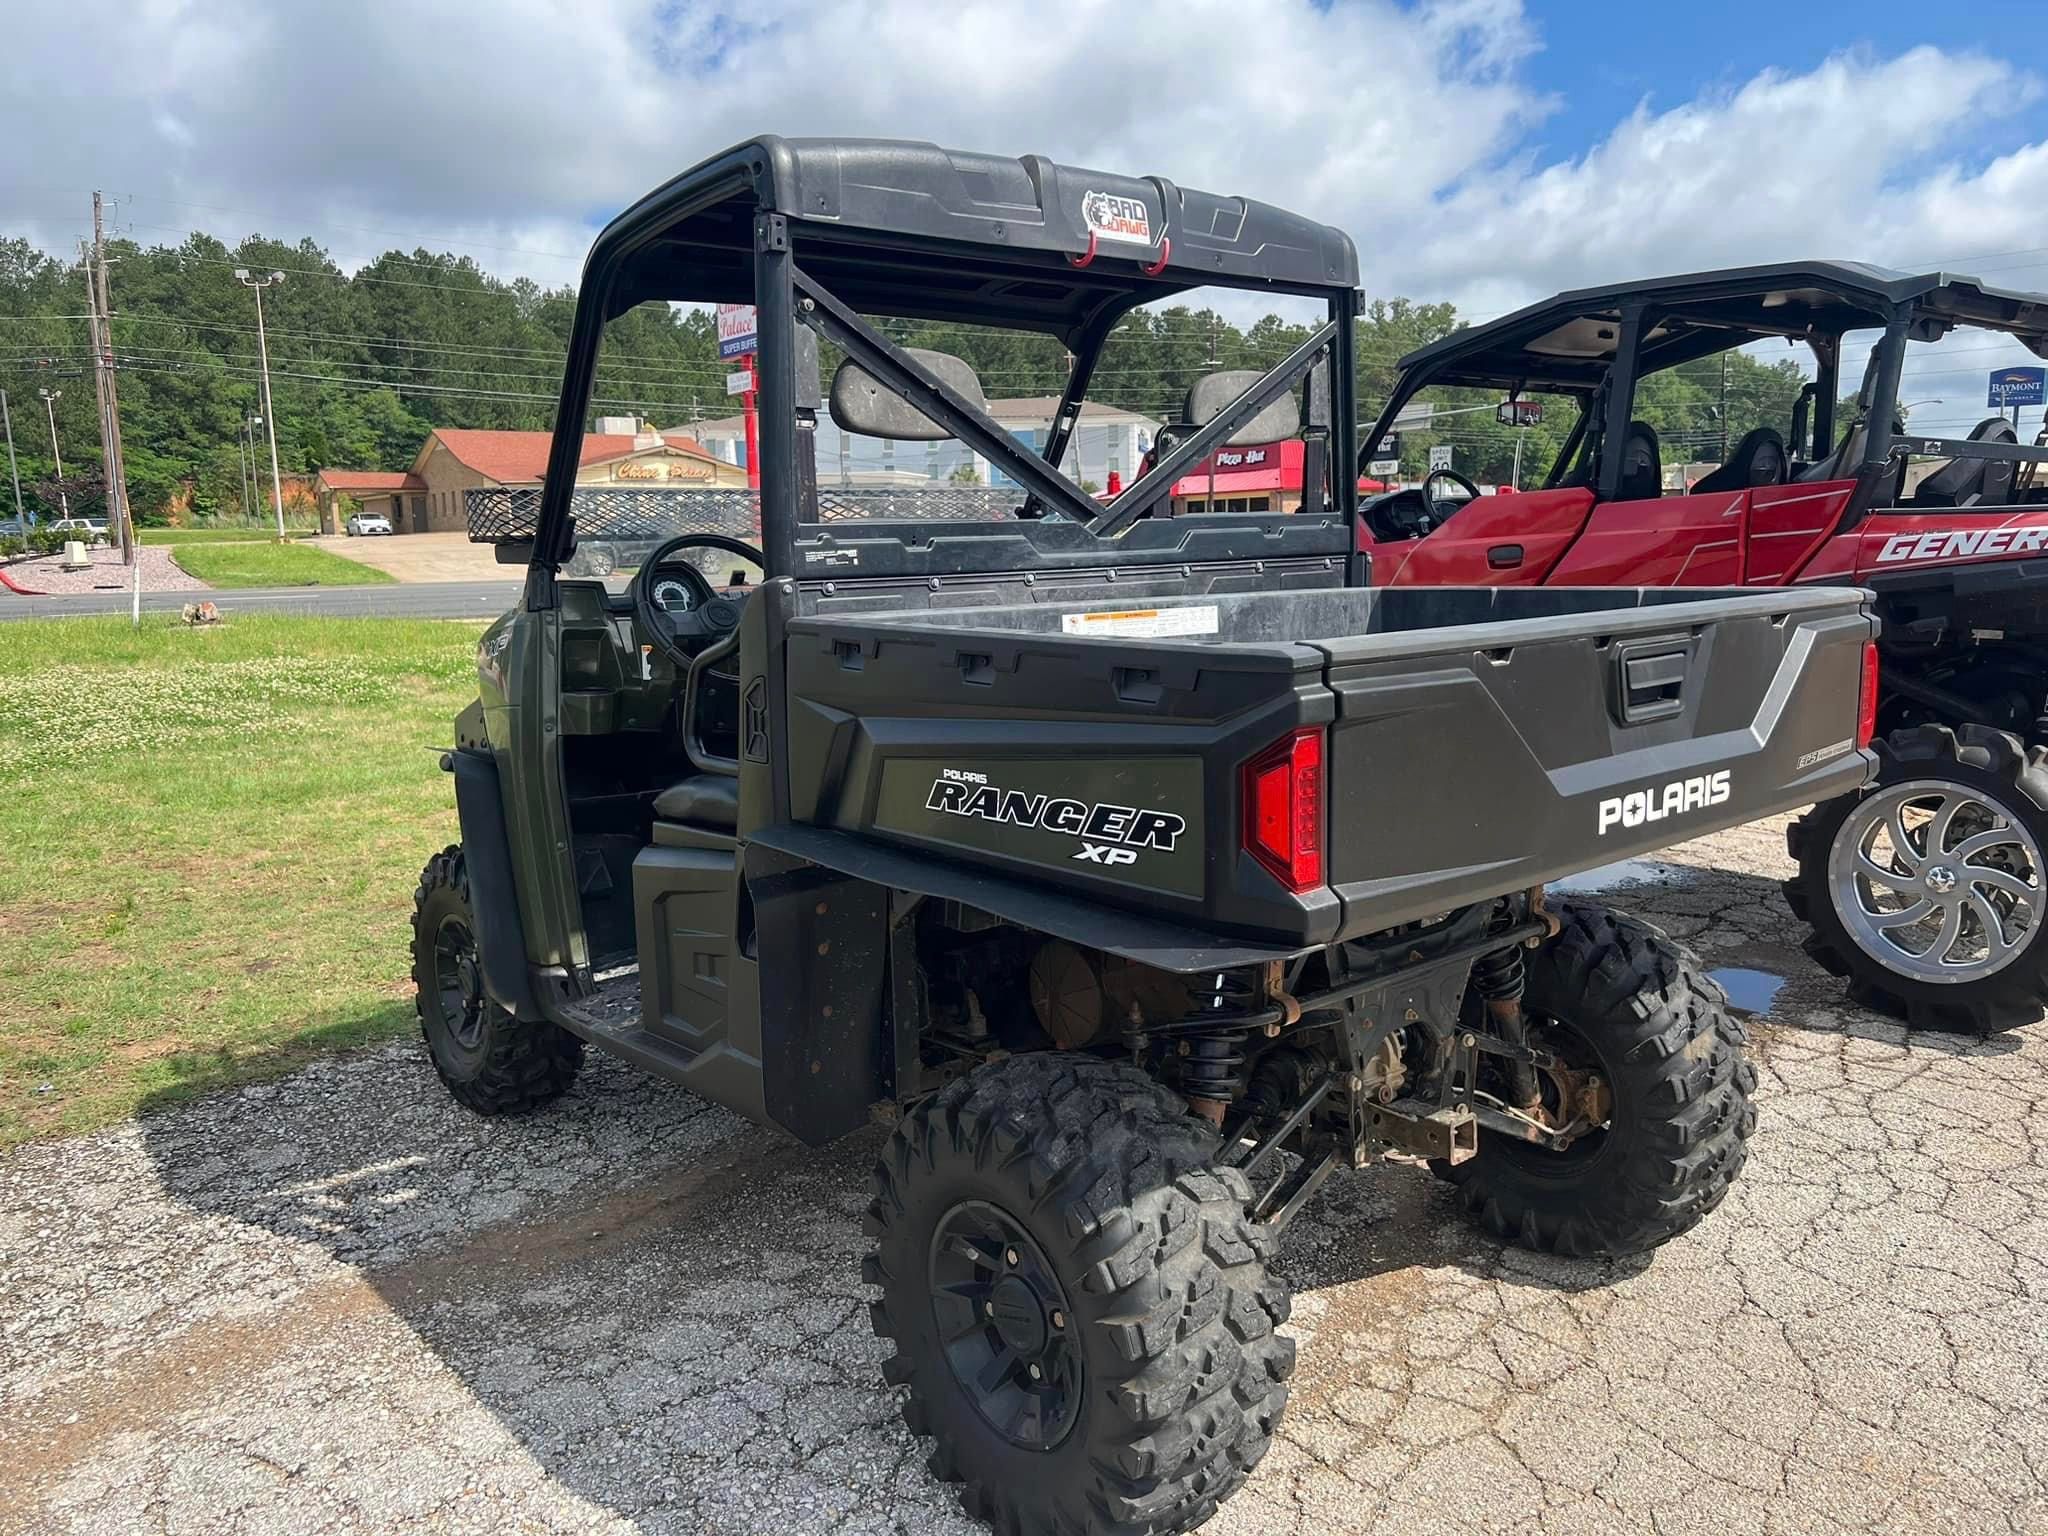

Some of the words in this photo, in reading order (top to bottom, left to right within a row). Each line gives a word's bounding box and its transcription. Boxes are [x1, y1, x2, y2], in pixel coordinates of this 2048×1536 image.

[1108, 198, 1146, 221] BAD
[1110, 217, 1148, 236] DAWG
[720, 316, 753, 337] Palace
[723, 341, 740, 354] SUPER
[741, 338, 758, 351] BUFFE
[1992, 381, 2042, 392] BAYMONT
[1216, 452, 1242, 466] Pizza
[1245, 450, 1265, 463] Hut
[943, 769, 987, 784] POLARIS
[1598, 769, 1731, 835] POLARIS
[925, 779, 1186, 851] RANGER
[1072, 842, 1138, 865] XP
